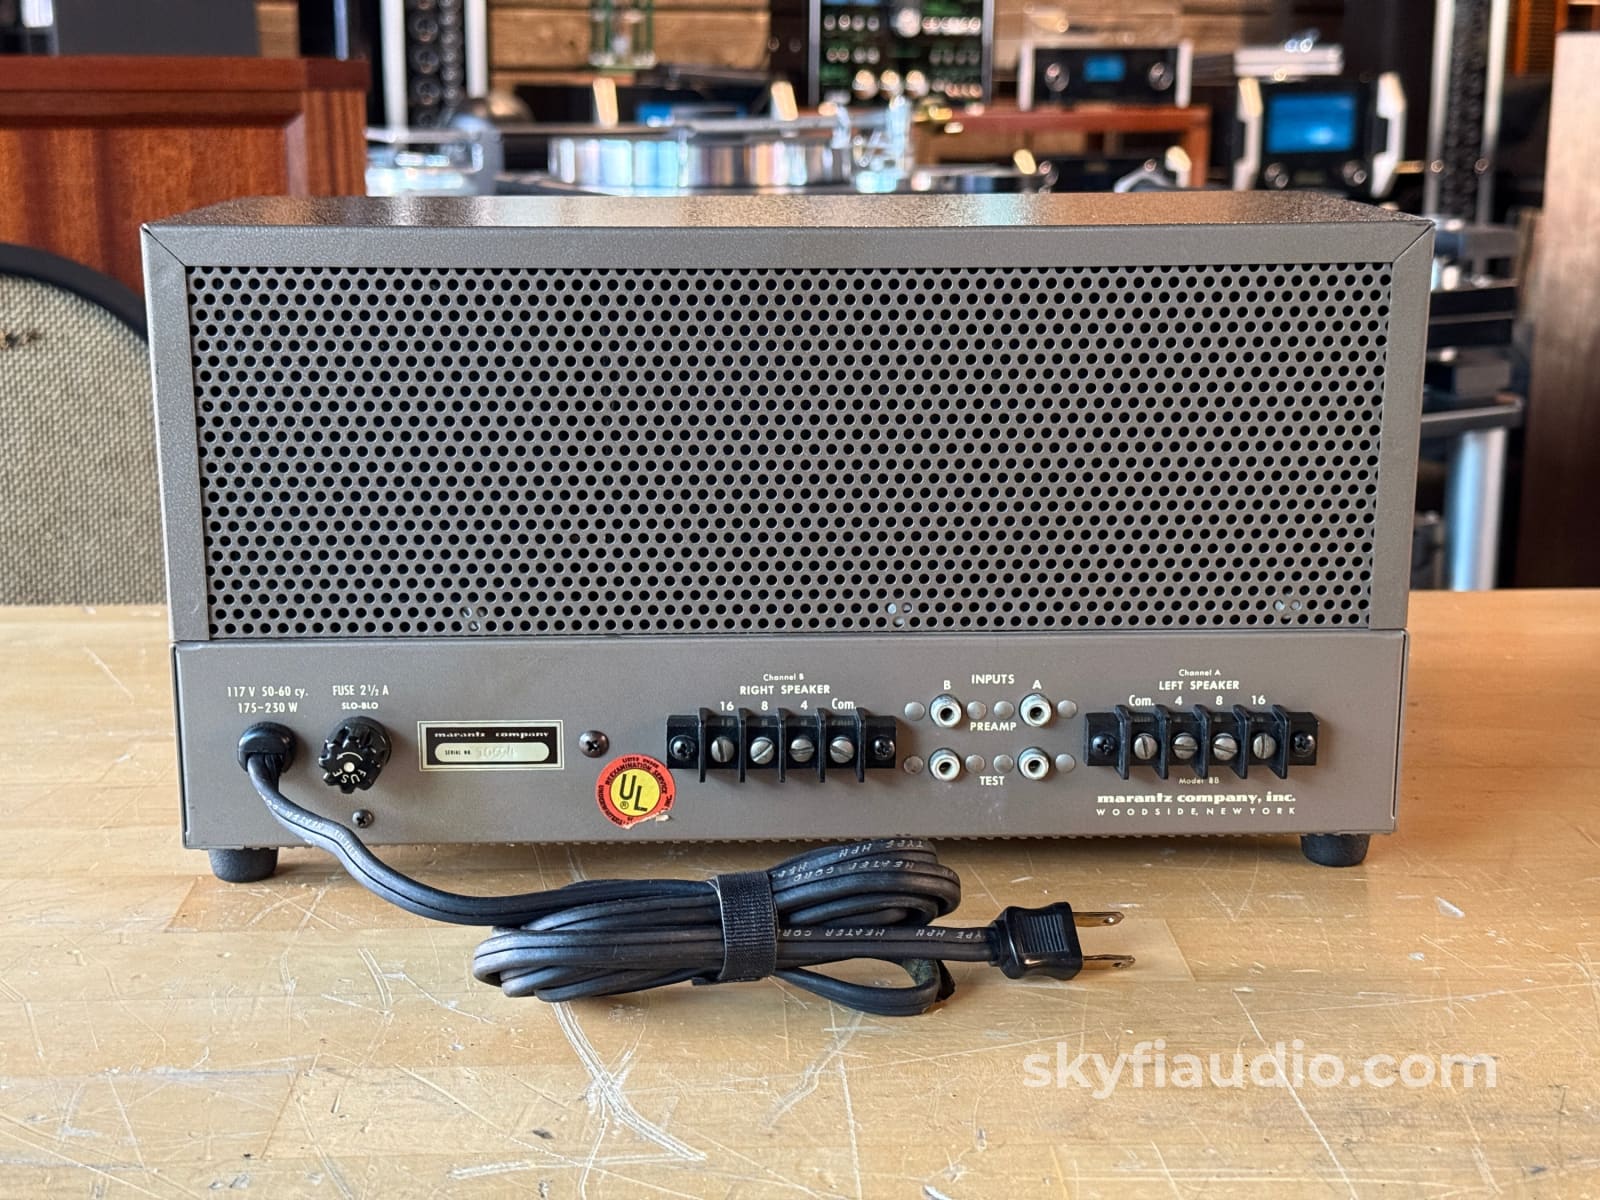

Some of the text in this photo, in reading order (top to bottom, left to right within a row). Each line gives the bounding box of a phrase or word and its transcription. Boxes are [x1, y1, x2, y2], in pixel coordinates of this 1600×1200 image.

[763, 673, 804, 681] Channel B
[1178, 668, 1212, 677] Channel
[943, 680, 951, 690] B
[971, 674, 1015, 685] INPUTS
[1032, 679, 1042, 690] A
[332, 685, 355, 696] FUSE
[382, 685, 389, 696] A
[740, 684, 831, 695] RIGHT SPEAKER
[1159, 680, 1240, 691] LEFT SPEAKER
[227, 686, 309, 699] 117 V 50-60 cy.
[719, 698, 857, 711] 16 8 4 Com.
[1128, 694, 1266, 706] Com. 4 8 16
[238, 702, 298, 713] 175-230 W
[341, 702, 379, 710] SLO-BLO
[970, 722, 1017, 731] PREAMP
[495, 731, 549, 739] company
[332, 768, 367, 784] FUSE
[979, 776, 1005, 786] TEST
[619, 773, 649, 812] UL
[1097, 791, 1296, 805] marantz company, inc.
[1206, 807, 1242, 816] NEW
[1249, 807, 1295, 815] YORK
[885, 839, 924, 849] TYPE
[771, 861, 808, 879] HEA
[793, 866, 834, 882] CORD
[777, 928, 986, 940] YPE HPN HEATER COR
